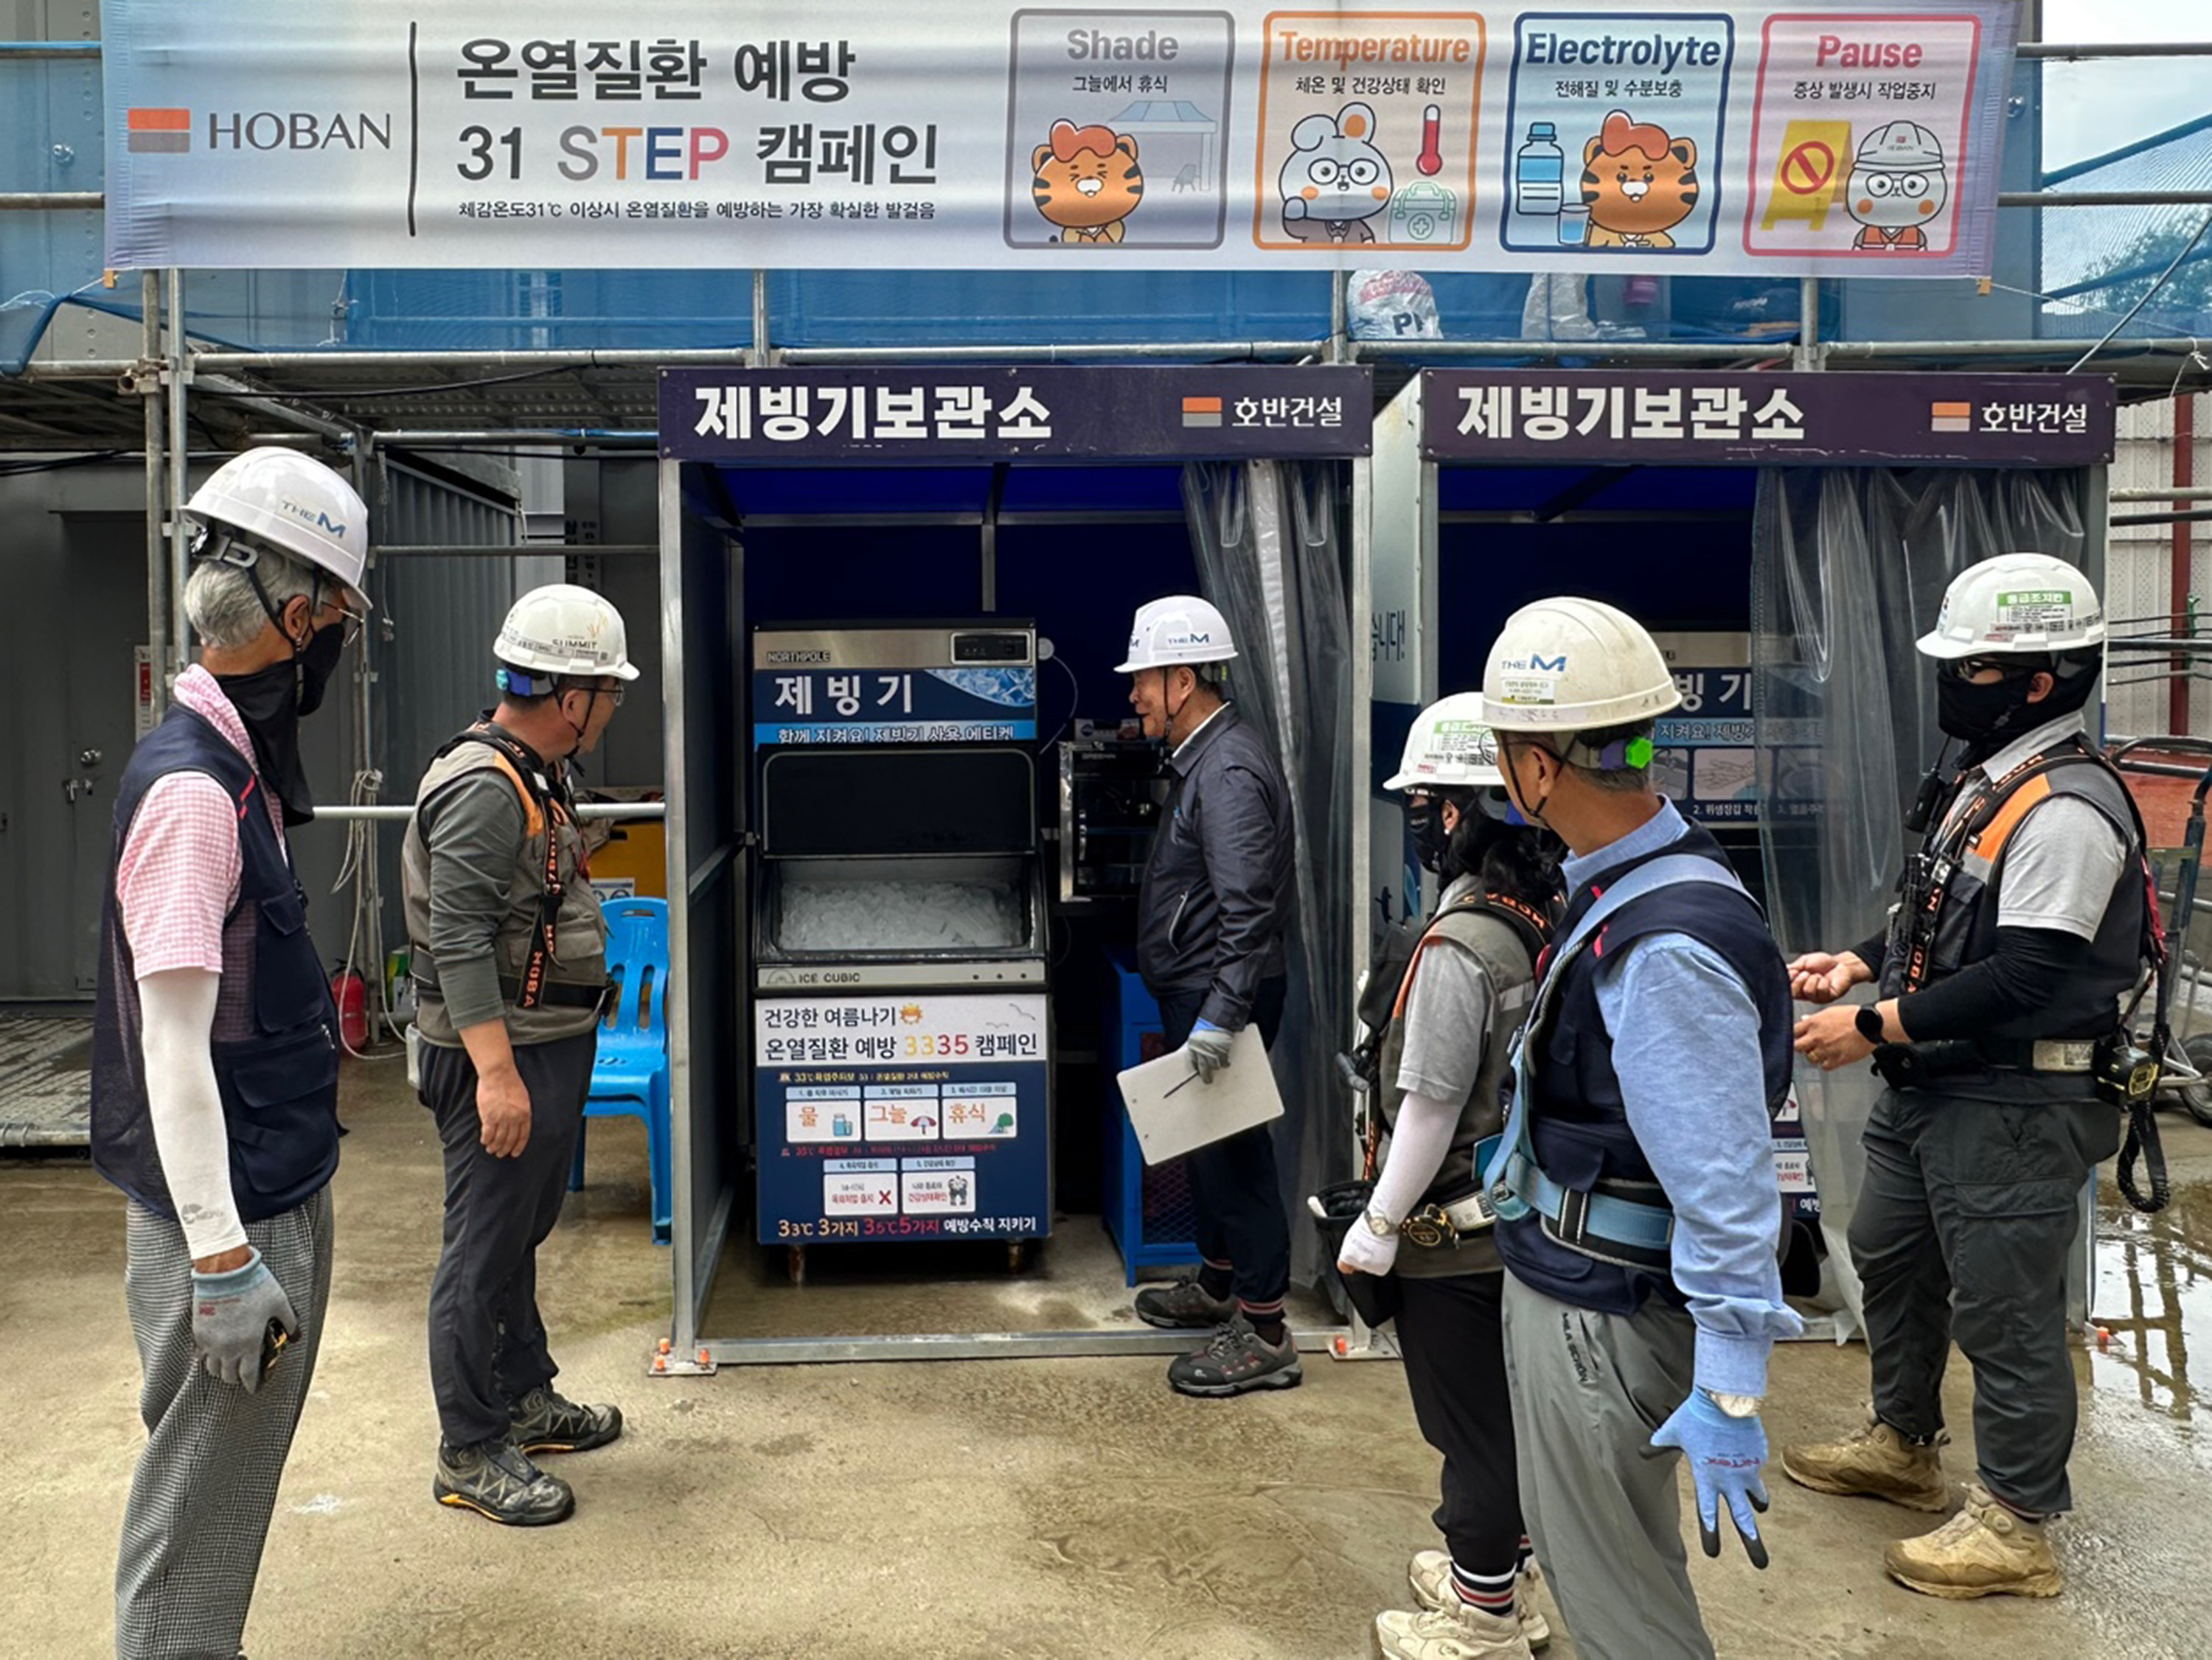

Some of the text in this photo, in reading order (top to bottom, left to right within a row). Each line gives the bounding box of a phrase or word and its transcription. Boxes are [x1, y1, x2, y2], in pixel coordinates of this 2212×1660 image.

[1068, 29, 1179, 62] Shade
[1279, 31, 1470, 72] Temperature
[1526, 33, 1721, 74] Electrolyte
[1815, 35, 1923, 69] Pause
[457, 39, 855, 102] 온열질환 예방
[1072, 75, 1168, 93] 그늘에서 휴식
[1295, 77, 1446, 95] 체온 및 건강상태 확인
[1555, 80, 1683, 98] 전해질 및 수분보충
[1792, 80, 1936, 100] 증상 발생시 작업중지
[209, 112, 391, 150] HOBAN
[457, 124, 937, 185] 31 STEP 캠페인
[570, 201, 620, 219] 이상시
[626, 201, 709, 219] 온열질환을
[717, 201, 783, 219] 예방하는
[790, 201, 823, 219] 가장
[830, 201, 879, 219] 확실한
[886, 201, 935, 219] 발걸음
[694, 386, 1051, 441] 제빙기보관소
[1231, 397, 1343, 428] 호반건설
[1457, 386, 1805, 441] 제빙기보관소
[1979, 402, 2087, 433] 호반건설
[767, 651, 831, 663] NORTHPOLE
[799, 972, 860, 984] ICE CUBIC
[765, 1006, 897, 1029] 건강한 여름나기
[765, 1033, 1037, 1061] 온열질환 예방 3335 캠페인
[799, 1106, 818, 1128] 물
[869, 1104, 908, 1125] 그늘
[948, 1103, 987, 1123] 휴식
[818, 1218, 859, 1236] 3가지
[943, 1217, 995, 1233] 예방수칙
[998, 1216, 1036, 1232] 지키기
